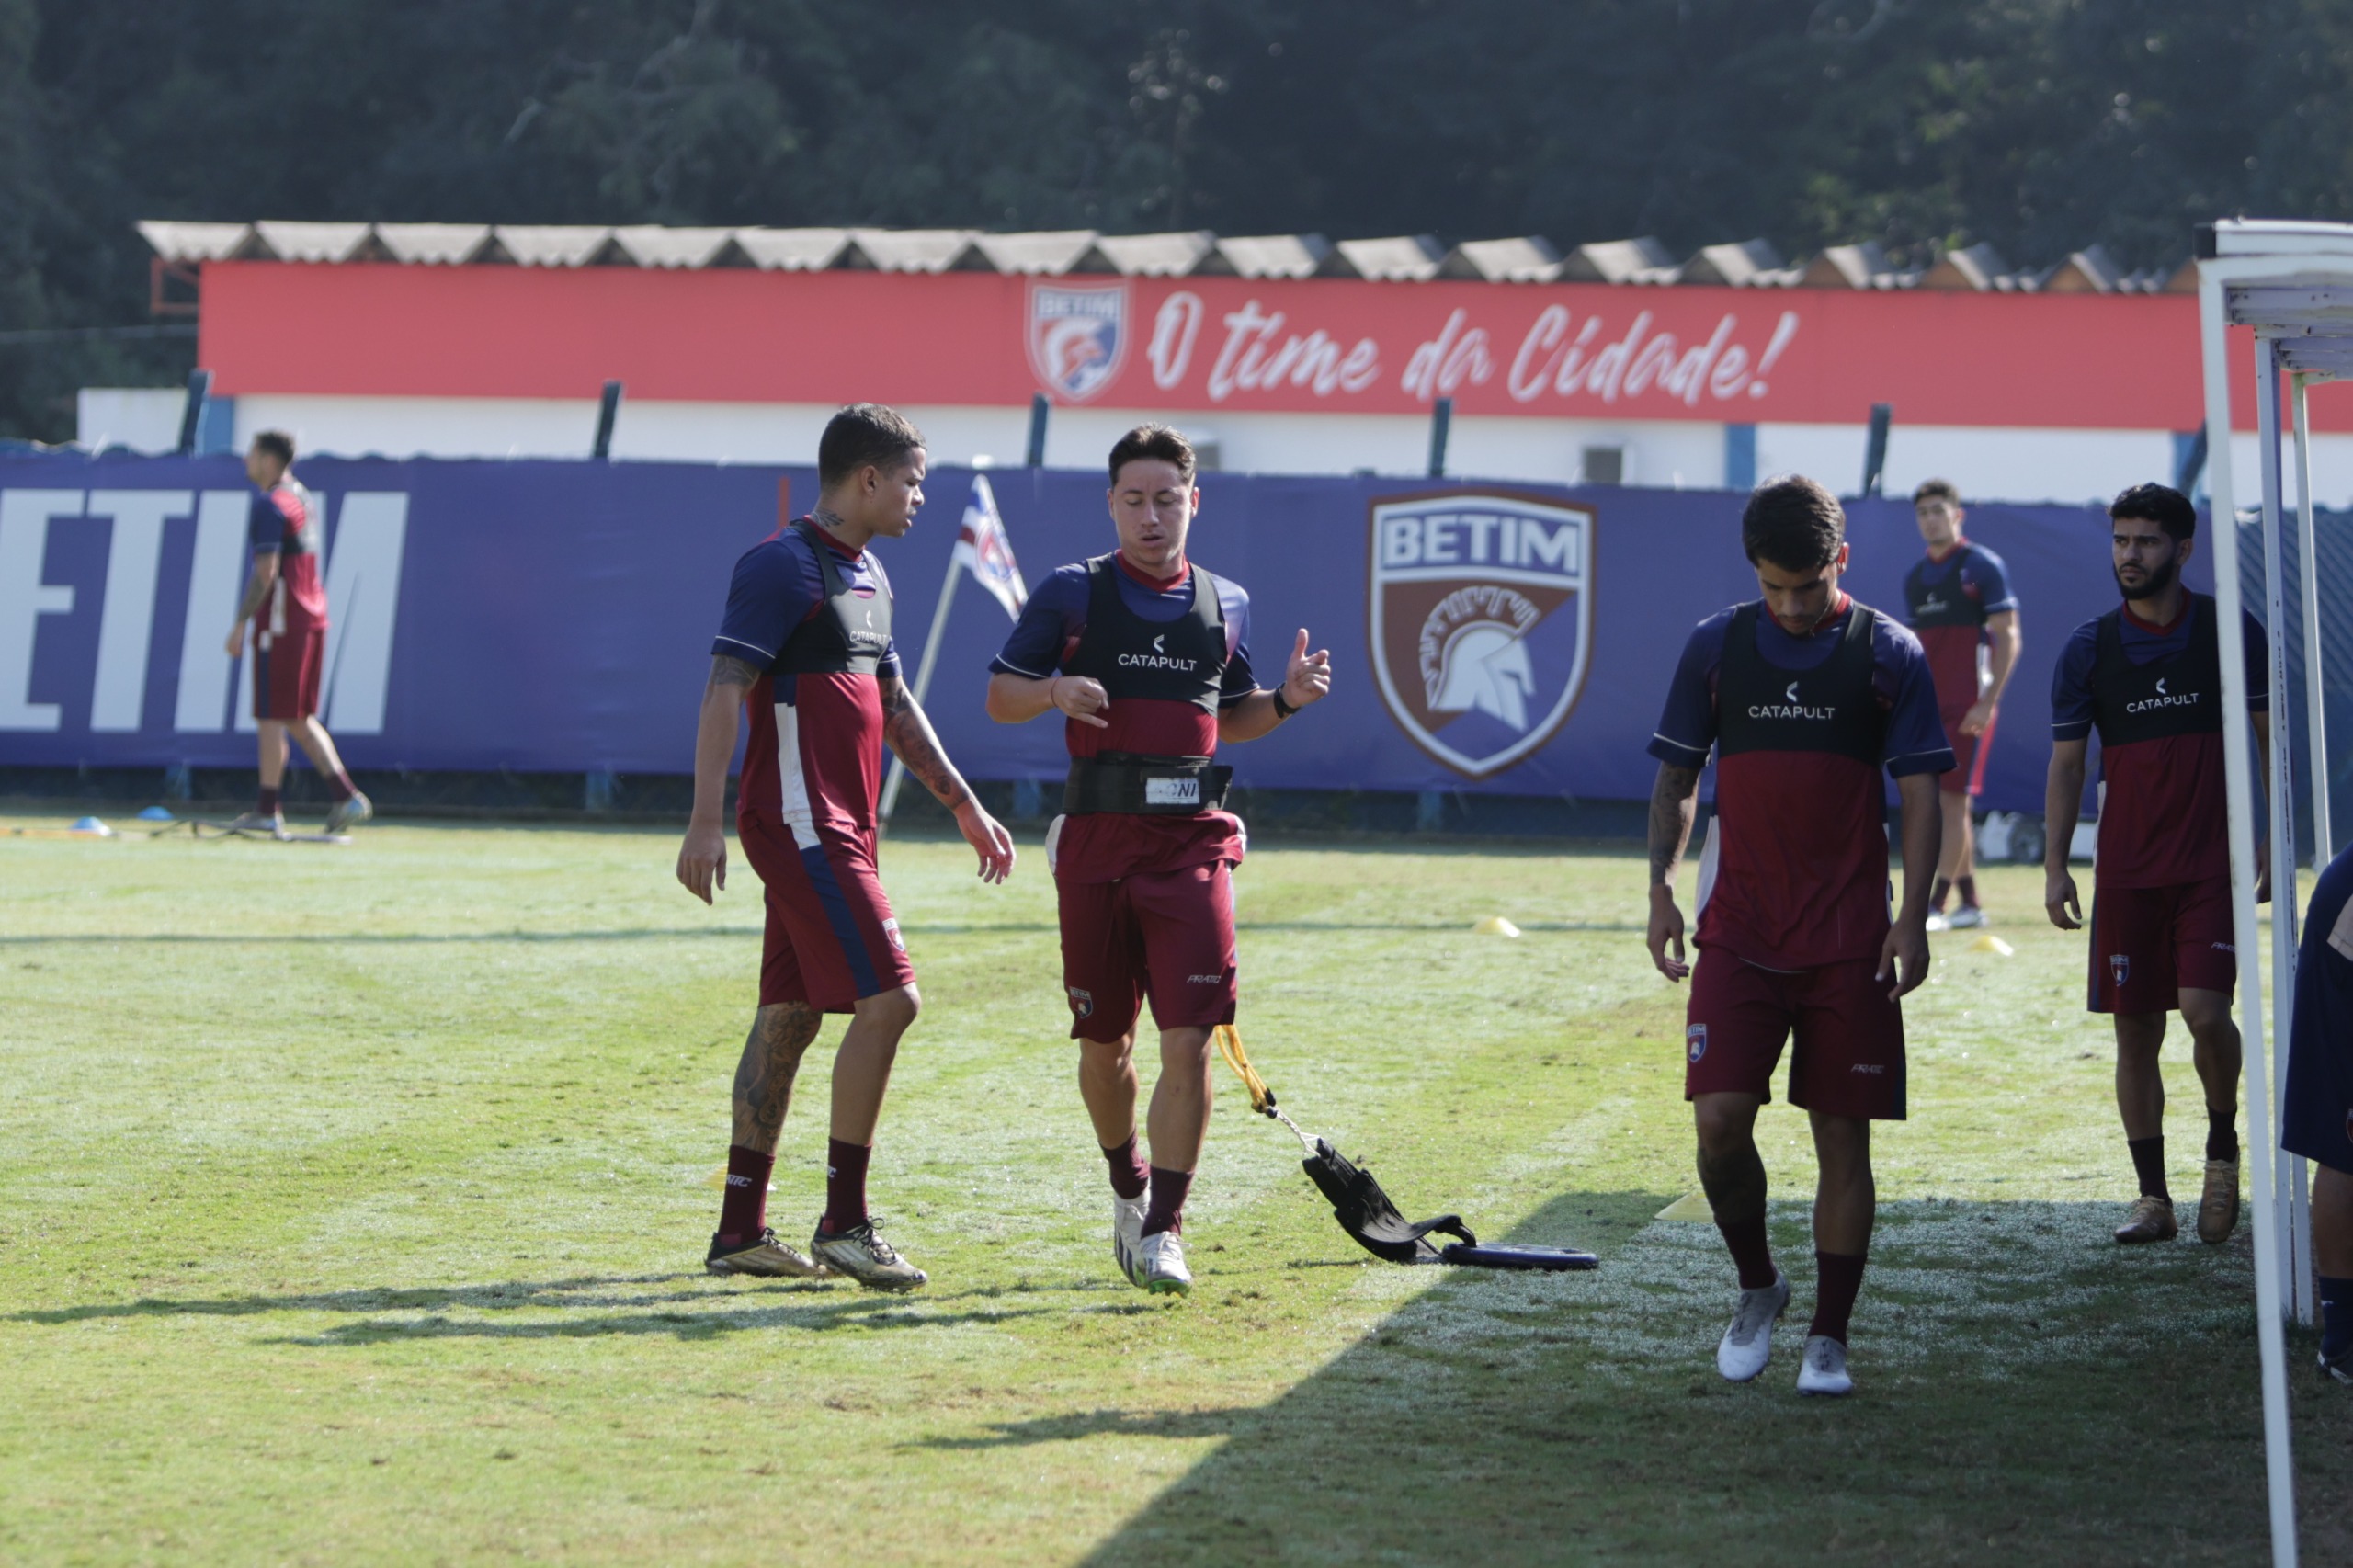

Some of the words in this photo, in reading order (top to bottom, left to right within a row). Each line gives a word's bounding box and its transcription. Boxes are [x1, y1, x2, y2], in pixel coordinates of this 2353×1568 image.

[1147, 290, 1204, 391] O
[1207, 299, 1381, 403] time
[1400, 307, 1496, 403] da
[1507, 304, 1800, 406] Cidade!
[1382, 513, 1580, 574] BETIM
[849, 631, 888, 645] CATAPULT
[1118, 653, 1197, 672] CATAPULT
[1748, 705, 1836, 720] CATAPULT
[2126, 692, 2200, 713] CATAPULT
